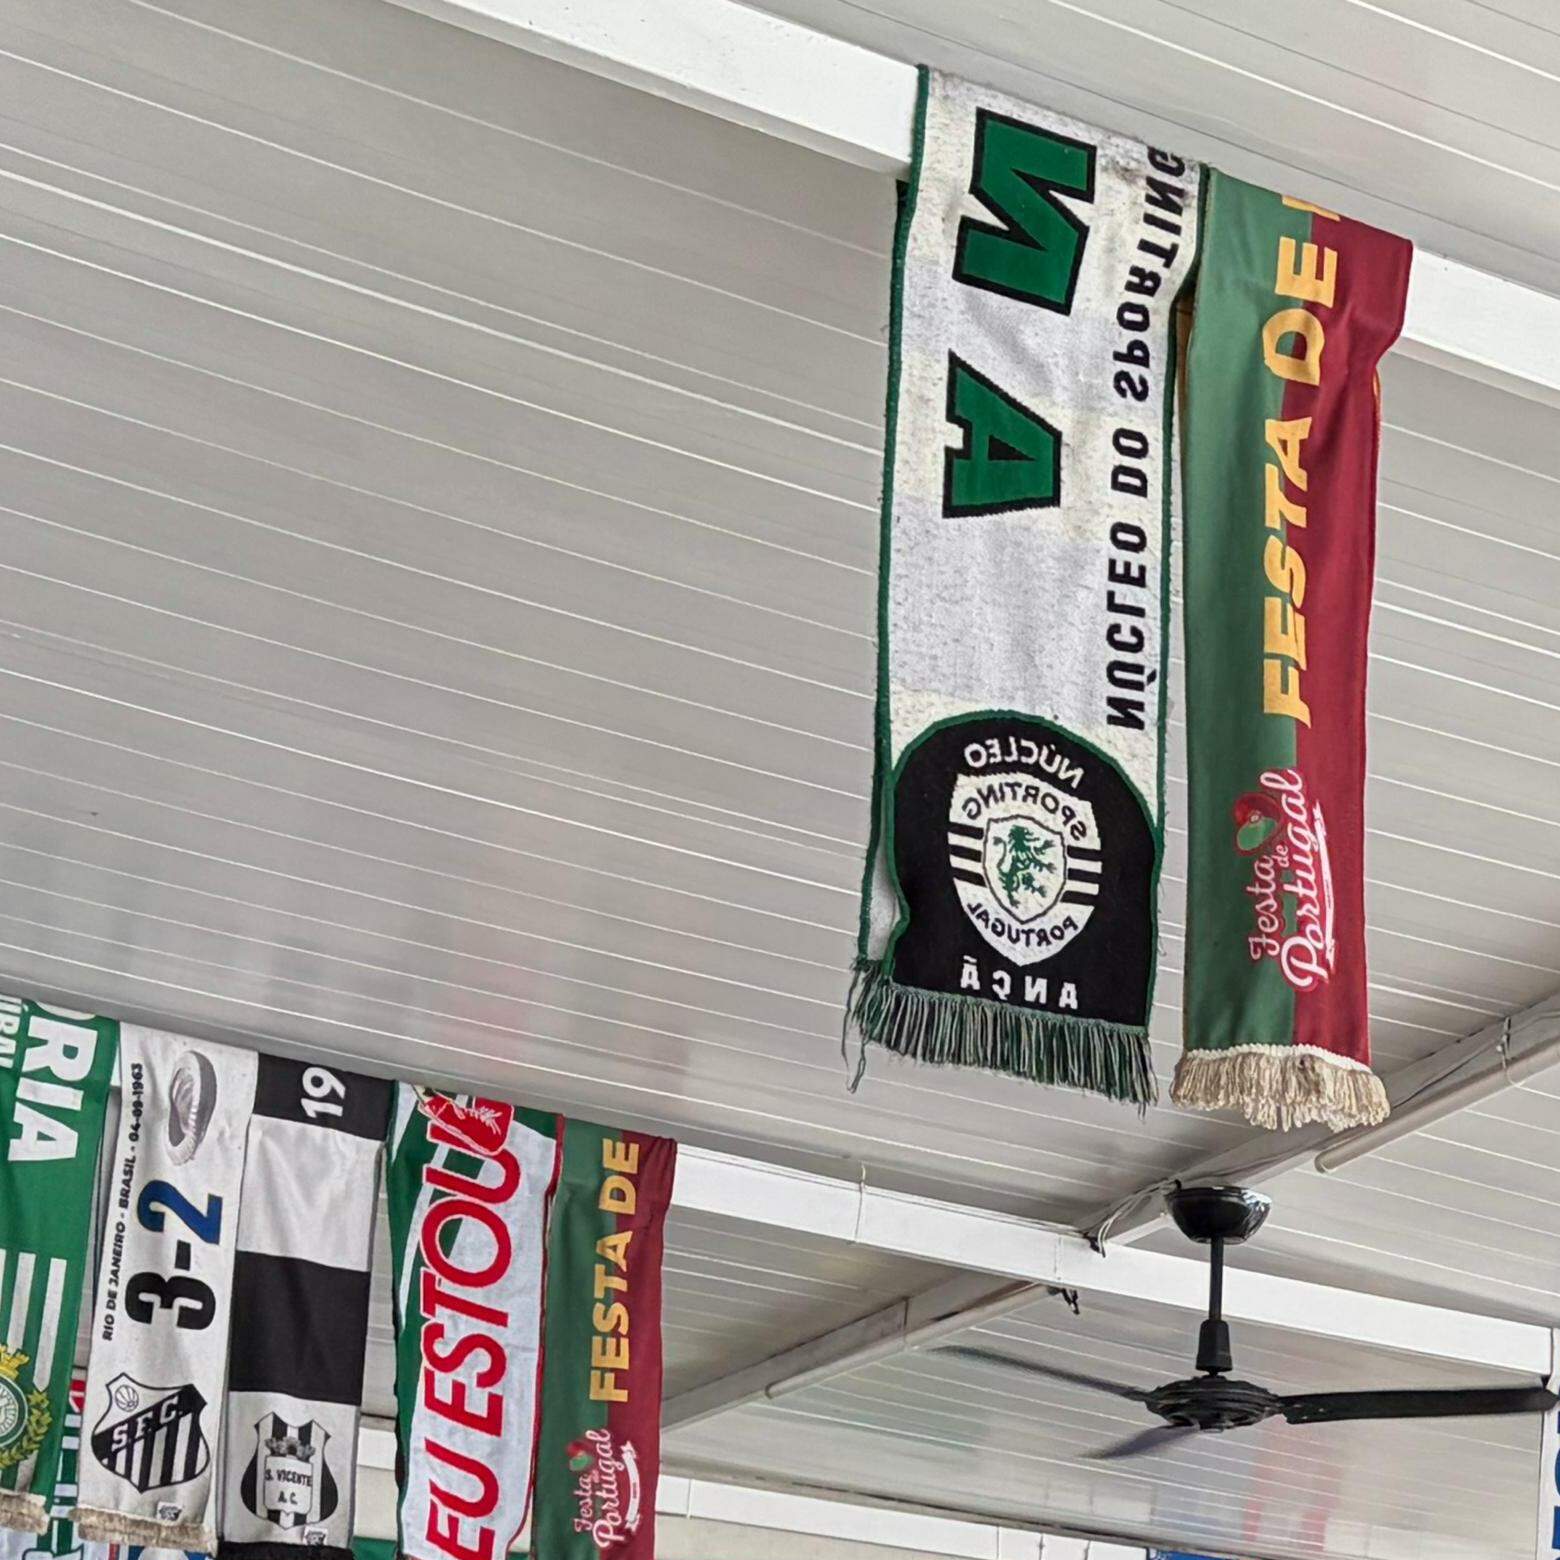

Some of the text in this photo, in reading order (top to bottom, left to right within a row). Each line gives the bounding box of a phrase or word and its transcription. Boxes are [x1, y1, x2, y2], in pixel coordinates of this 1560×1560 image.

[1261, 236, 1339, 386] DE
[1262, 416, 1313, 729] FESTA
[1250, 854, 1282, 961] Festa
[1259, 767, 1331, 992] Portugal
[8, 1001, 99, 1161] RIA
[300, 1066, 347, 1119] 19
[118, 1155, 137, 1210] BRASIL
[105, 1289, 118, 1311] DE
[109, 1221, 127, 1287] JANEIRO
[125, 1179, 223, 1331] 3-2
[419, 1117, 523, 1437] ESTOU
[589, 1139, 640, 1404] FESTA DE
[101, 1313, 116, 1342] RIO
[585, 1428, 625, 1548] Portugal
